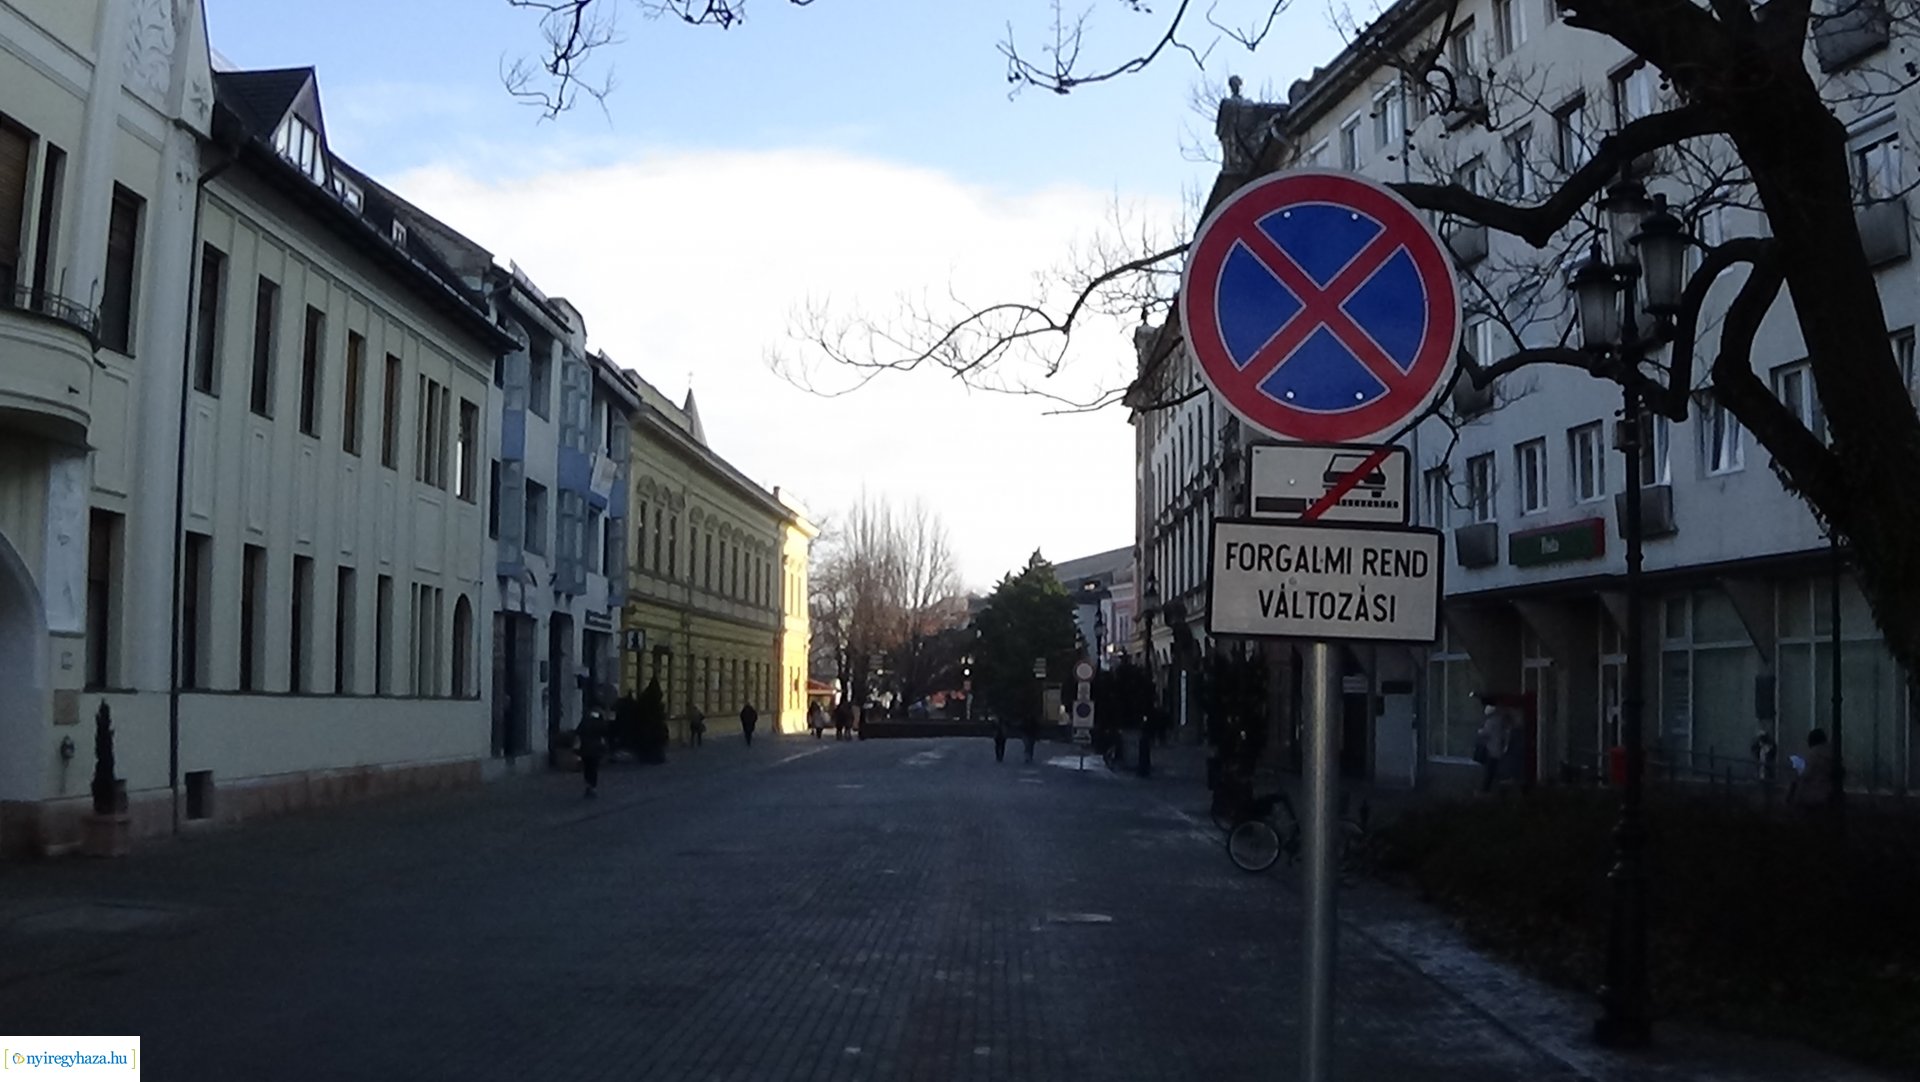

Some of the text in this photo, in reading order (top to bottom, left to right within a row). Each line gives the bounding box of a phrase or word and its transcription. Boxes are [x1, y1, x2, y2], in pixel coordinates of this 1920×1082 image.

[1225, 542, 1428, 578] FORGALMI REND
[1258, 583, 1395, 623] VÁLTOZÁSI
